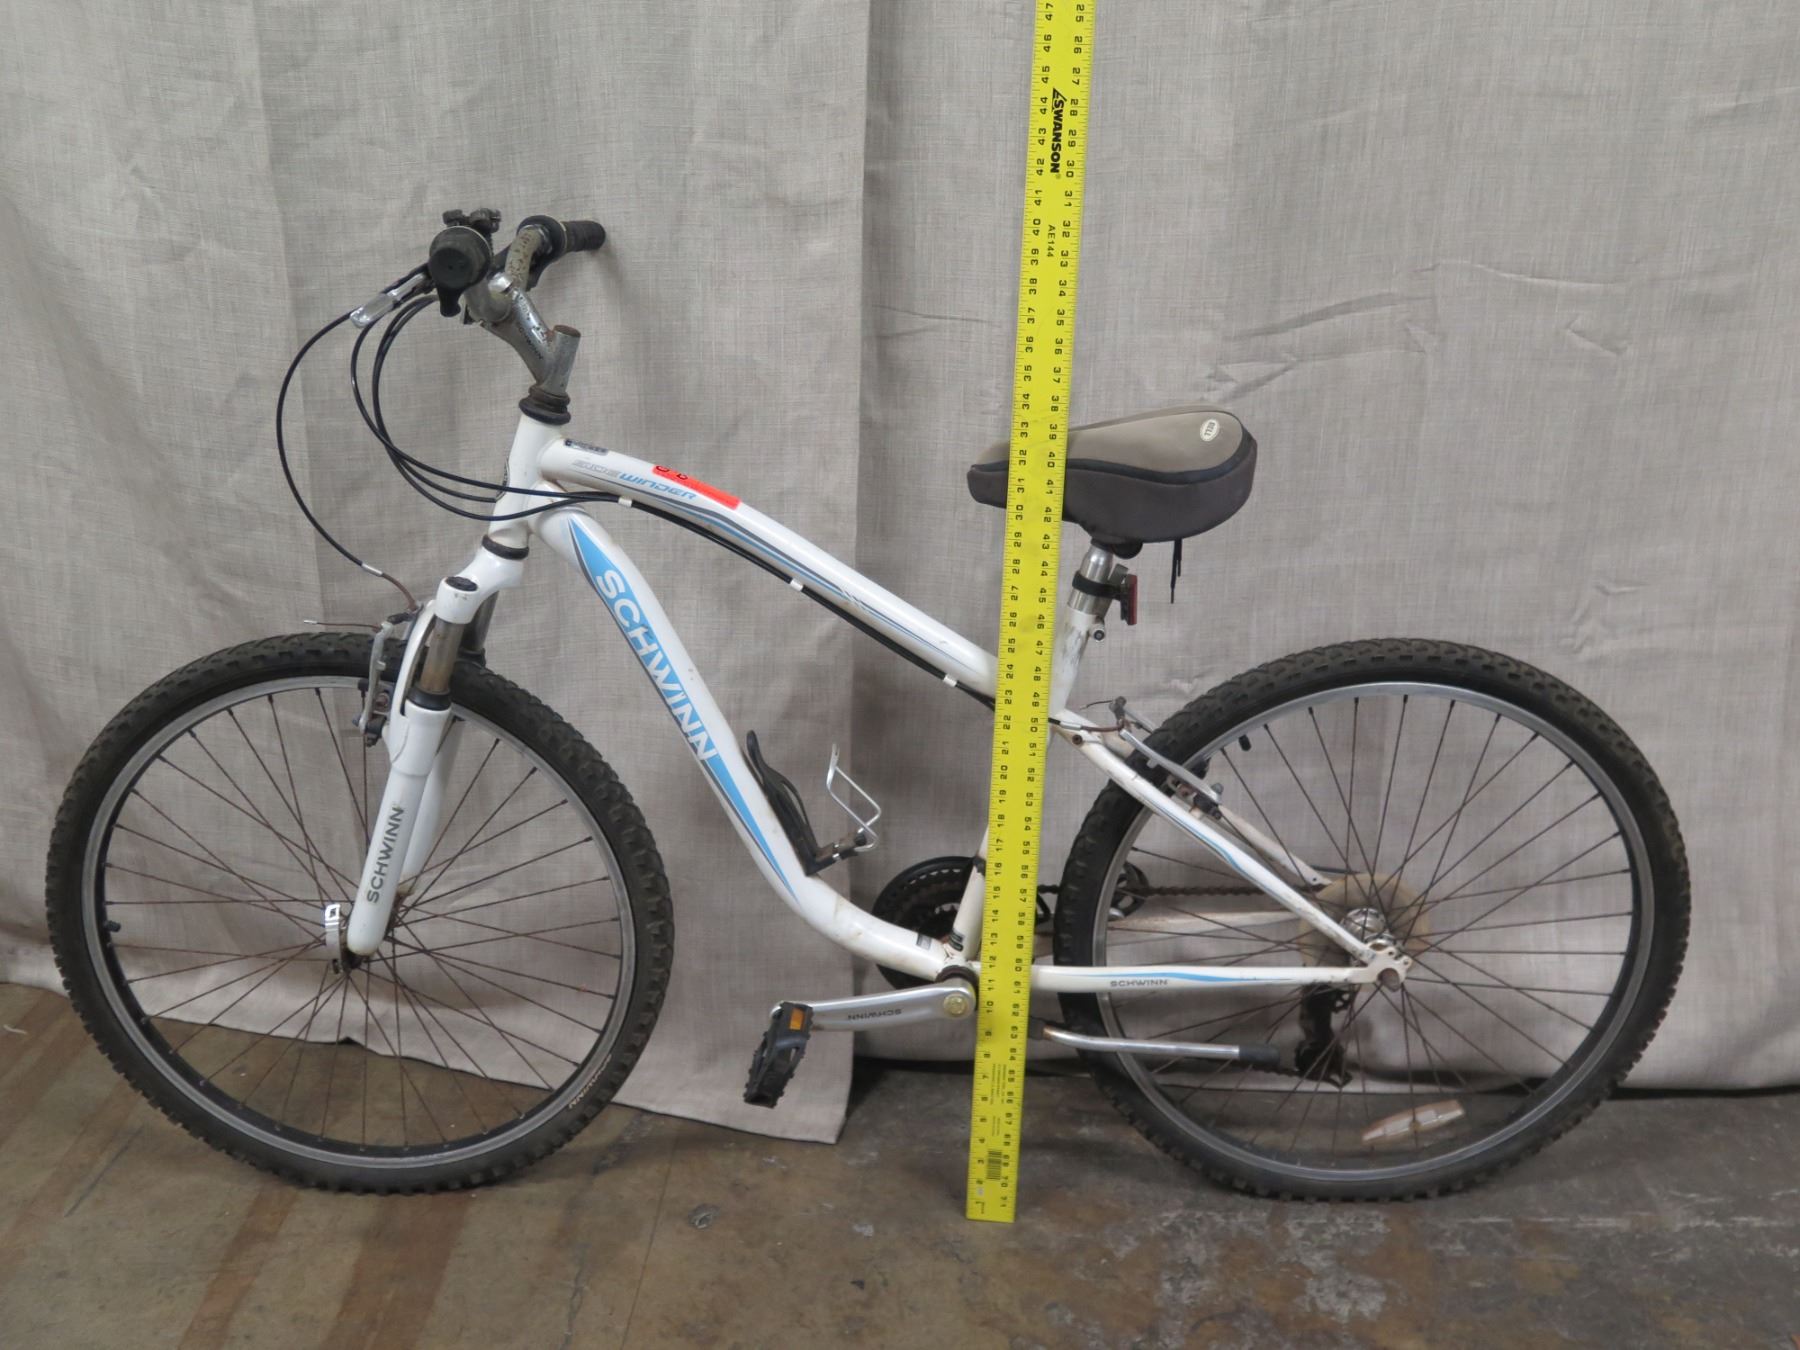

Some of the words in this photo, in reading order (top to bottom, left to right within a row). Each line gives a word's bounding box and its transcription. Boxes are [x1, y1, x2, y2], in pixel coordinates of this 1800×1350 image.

[1046, 3, 1053, 20] 47
[1076, 4, 1084, 22] 25
[1044, 34, 1052, 52] 46
[1074, 36, 1083, 53] 26
[1042, 66, 1050, 83] 45
[1072, 67, 1080, 85] 27
[1040, 97, 1048, 114] 44
[1070, 99, 1078, 116] 28
[1038, 128, 1046, 145] 43
[1050, 100, 1064, 173] SWANSON
[1068, 129, 1076, 147] 29
[1036, 158, 1044, 175] 42
[1066, 160, 1074, 177] 30
[1034, 190, 1042, 206] 41
[1064, 191, 1072, 206] 31
[1033, 219, 1041, 236] 40
[1062, 221, 1070, 238] 32
[1047, 224, 1055, 257] AE144
[1031, 248, 1039, 265] 39
[1060, 250, 1068, 267] 33
[1029, 278, 1037, 294] 38
[1059, 280, 1067, 296] 34
[1027, 308, 1035, 324] 37
[1057, 309, 1065, 326] 35
[1026, 337, 1033, 352] 36
[1055, 338, 1063, 354] 36
[1024, 365, 1032, 381] 35
[1053, 367, 1061, 383] 37
[1022, 394, 1030, 410] 34
[1051, 396, 1059, 412] 38
[1020, 422, 1029, 438] 33
[1049, 424, 1057, 440] 39
[1019, 450, 1026, 466] 32
[1048, 452, 1055, 468] 40
[1017, 478, 1024, 493] 31
[1046, 480, 1054, 494] 41
[1016, 505, 1023, 520] 30
[1044, 507, 1052, 522] 42
[1014, 532, 1021, 547] 29
[1042, 534, 1050, 549] 43
[1012, 559, 1020, 574] 28
[1041, 561, 1048, 576] 44
[1011, 586, 1018, 601] 27
[1039, 588, 1046, 603] 45
[1009, 612, 1017, 627] 26
[1037, 614, 1045, 629] 46
[1008, 638, 1016, 653] 25
[1035, 641, 1043, 655] 47
[596, 570, 718, 760] SCHWINN
[1006, 664, 1013, 679] 24
[1034, 667, 1042, 681] 48
[1005, 690, 1012, 704] 23
[1032, 692, 1040, 707] 49
[1003, 715, 1011, 730] 22
[1030, 718, 1038, 732] 50
[1002, 741, 1009, 755] 21
[1029, 743, 1037, 756] 51
[1000, 765, 1008, 780] 20
[1027, 768, 1035, 782] 52
[999, 790, 1006, 803] 19
[1026, 792, 1033, 806] 53
[997, 814, 1005, 827] 18
[1024, 817, 1032, 831] 54
[996, 839, 1003, 851] 17
[1023, 841, 1030, 855] 55
[366, 806, 404, 903] SCHWINN
[995, 863, 1002, 875] 16
[1021, 865, 1028, 878] 56
[993, 886, 1000, 899] 15
[1019, 889, 1027, 902] 57
[1110, 979, 1168, 988] SCHWINN
[848, 1008, 902, 1021] SCHWINN
